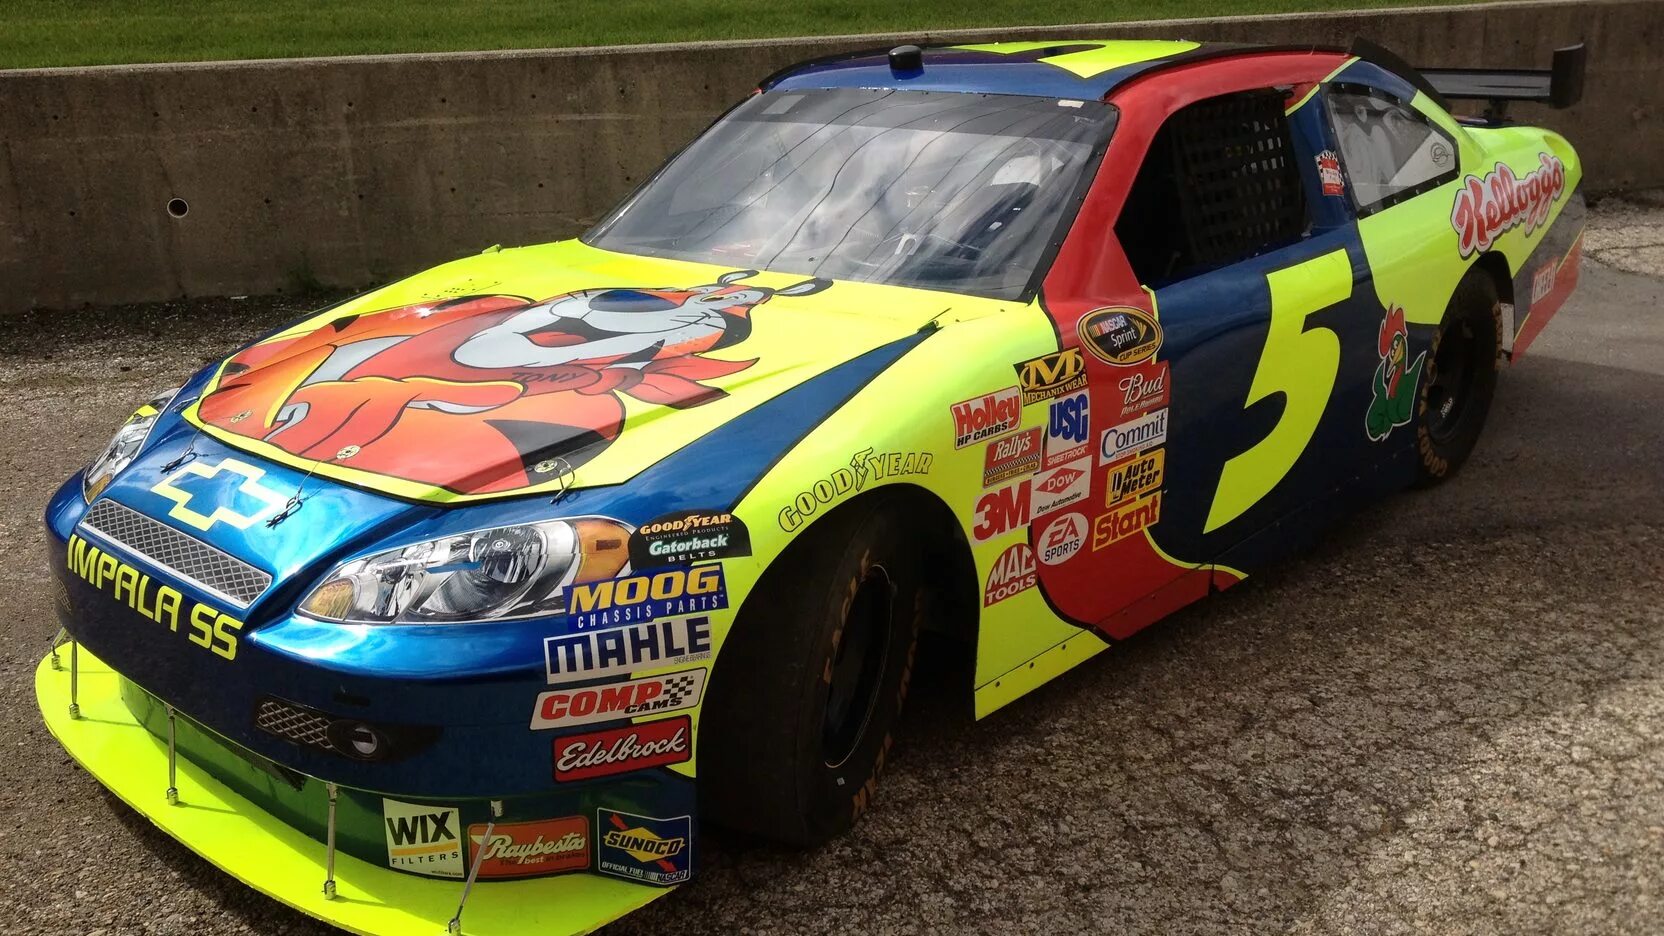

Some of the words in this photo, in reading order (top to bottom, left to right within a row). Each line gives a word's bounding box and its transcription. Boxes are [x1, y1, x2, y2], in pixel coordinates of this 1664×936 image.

[1454, 154, 1563, 252] Kellogg's
[1101, 315, 1127, 334] NASCAR
[1111, 327, 1137, 348] Sprint
[1120, 351, 1132, 361] CUP
[1133, 343, 1156, 356] SERIES
[511, 371, 590, 384] TONY
[1023, 386, 1065, 404] MECHANIX
[1064, 374, 1088, 393] WEAR
[1118, 368, 1166, 405] Bud
[1202, 248, 1353, 534] 5
[953, 394, 1020, 436] Holley
[1050, 394, 1088, 443] USG
[957, 436, 972, 447] HP
[973, 422, 1008, 441] CARBS
[994, 433, 1031, 461] Rally's
[1102, 412, 1164, 458] Commit
[1047, 446, 1087, 467] SHEETROCK
[1124, 458, 1155, 481] Auto
[778, 447, 933, 532] GOODYEAR
[1121, 470, 1160, 500] Meter
[973, 479, 1032, 541] 3M
[1037, 504, 1051, 514] Dow
[1051, 492, 1082, 508] Automotive
[640, 515, 731, 535] GOODYEAR
[1047, 516, 1080, 549] EA
[1095, 497, 1158, 548] Stant
[649, 535, 728, 556] Gatorback
[668, 551, 716, 562] BELTS
[1044, 539, 1080, 562] SPORTS
[987, 544, 1037, 591] MAC
[67, 534, 183, 632] IMPALA
[188, 603, 244, 661] SS
[569, 565, 721, 615] MOOG
[986, 574, 1036, 604] TOOLS
[578, 605, 652, 629] CHASSIS
[666, 595, 718, 614] PARTS
[547, 616, 711, 675] MAHLE
[540, 681, 662, 721] COMP
[624, 697, 683, 715] CAMS
[556, 727, 687, 772] Edelbrock
[386, 811, 456, 846] WIX
[607, 832, 679, 855] SUNOCO
[391, 851, 459, 865] FILTERS
[471, 832, 586, 865] Raybestos
[524, 856, 544, 865] best
[602, 861, 629, 873] OFFICIAL
[629, 866, 644, 877] FUEL
